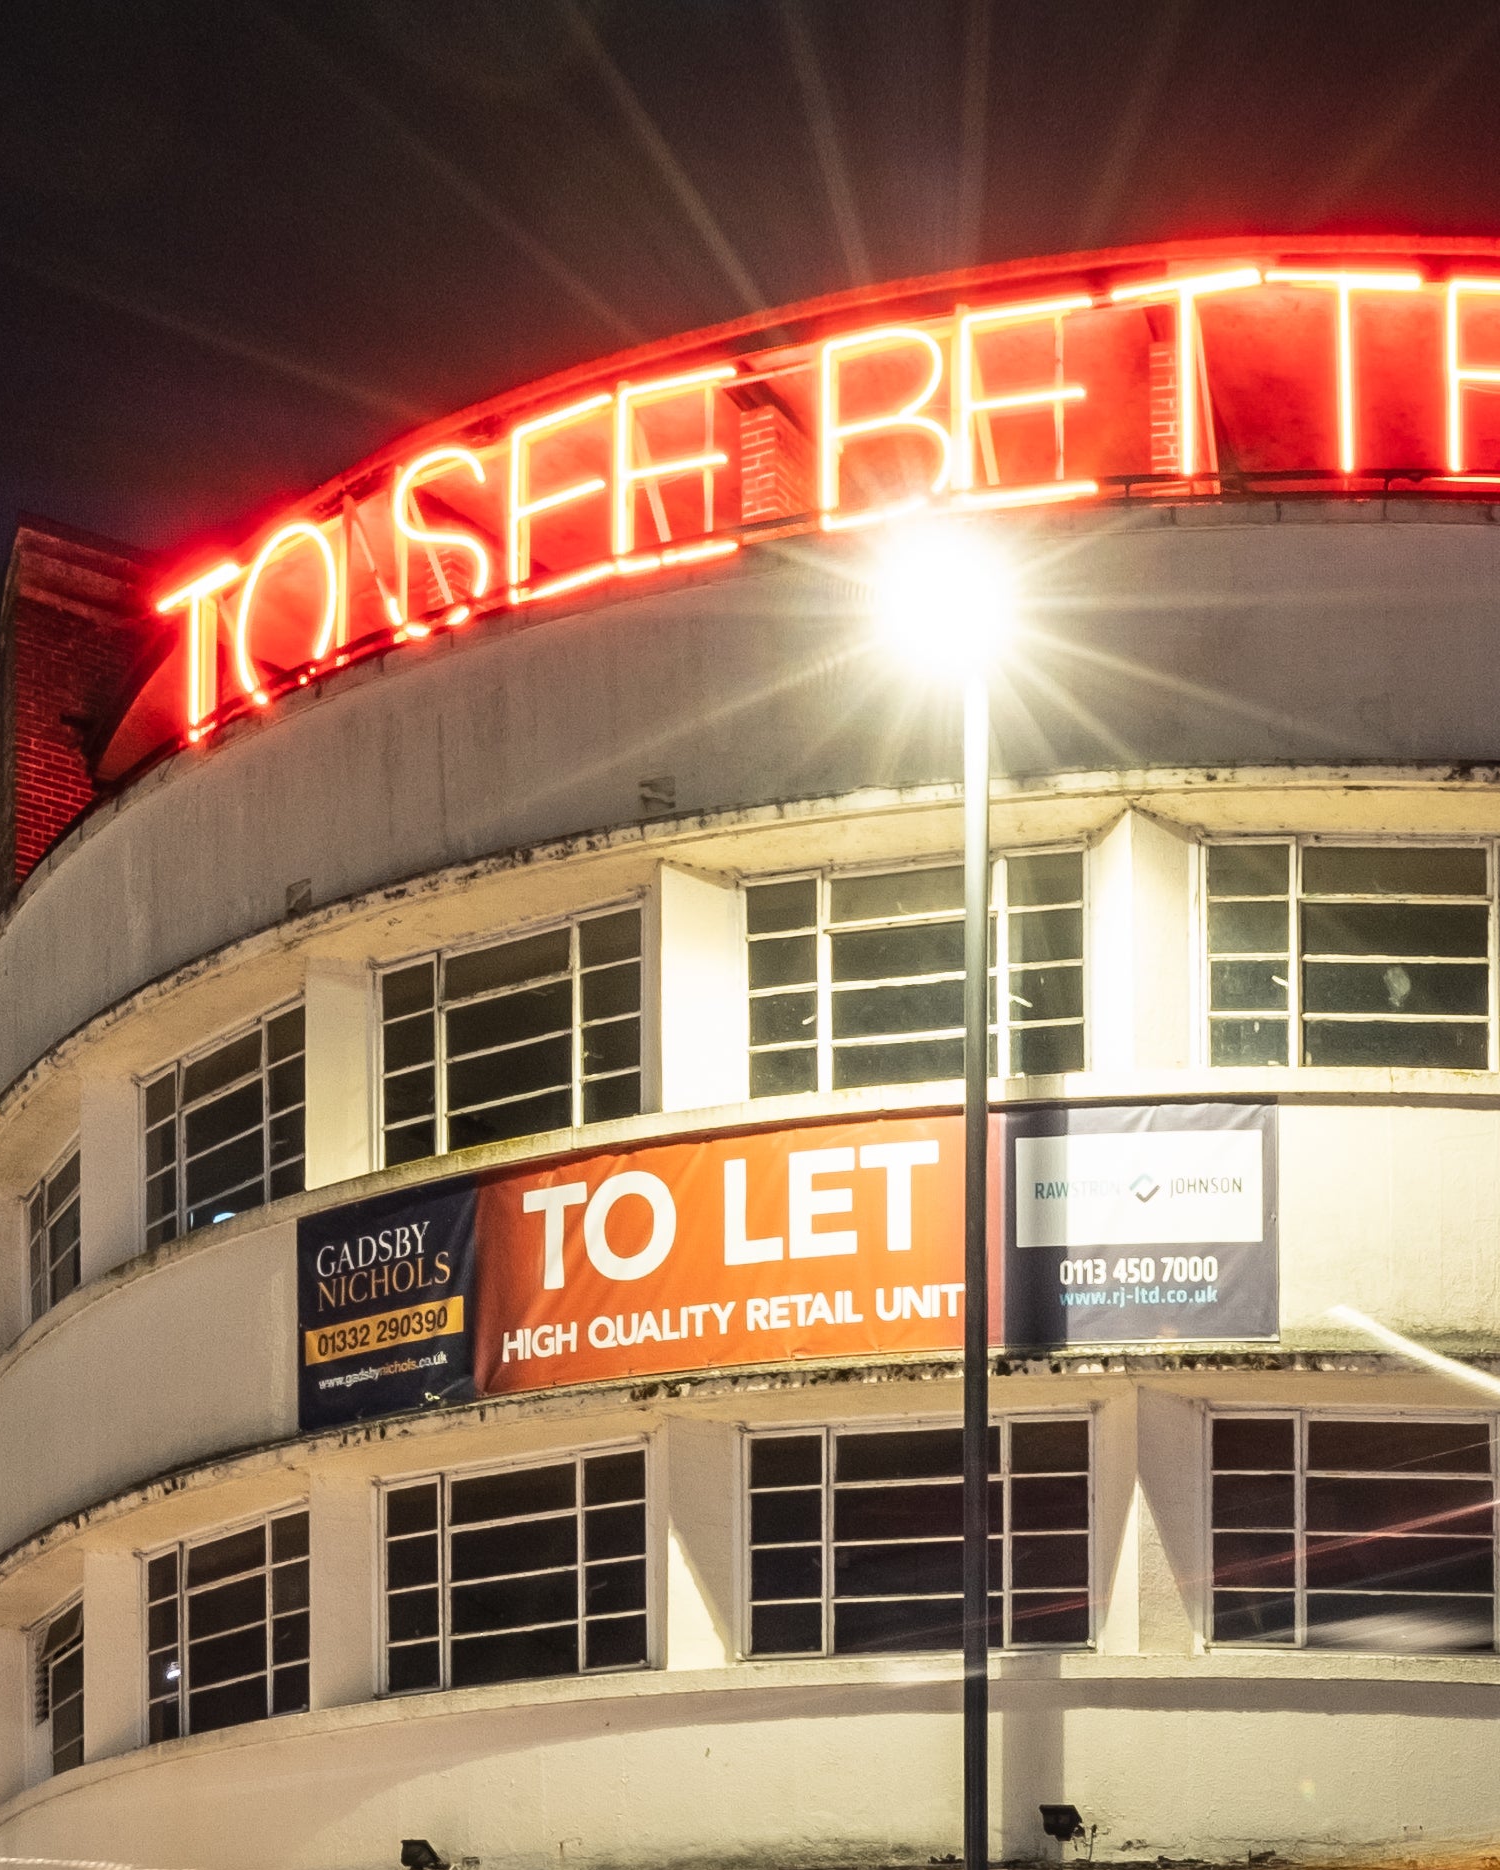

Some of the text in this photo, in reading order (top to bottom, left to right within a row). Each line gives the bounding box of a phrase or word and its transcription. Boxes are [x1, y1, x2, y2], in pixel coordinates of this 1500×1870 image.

[154, 519, 340, 742] TO
[392, 365, 739, 640] SEE
[1170, 1177, 1243, 1198] JOHNSON
[523, 1140, 939, 1290] TO LET
[316, 1221, 430, 1277] GADSBY
[1060, 1256, 1218, 1285] 0113 450 7000
[317, 1251, 451, 1311] NICHOLS
[1060, 1285, 1218, 1308] www.rj-ltd.co.uk
[317, 1306, 447, 1357] 01332 290390
[502, 1321, 578, 1363] HIGH
[587, 1301, 736, 1349] QUALITY
[746, 1290, 863, 1331] RETAIL
[318, 1351, 448, 1390] www.gadsbynichols.co.uk
